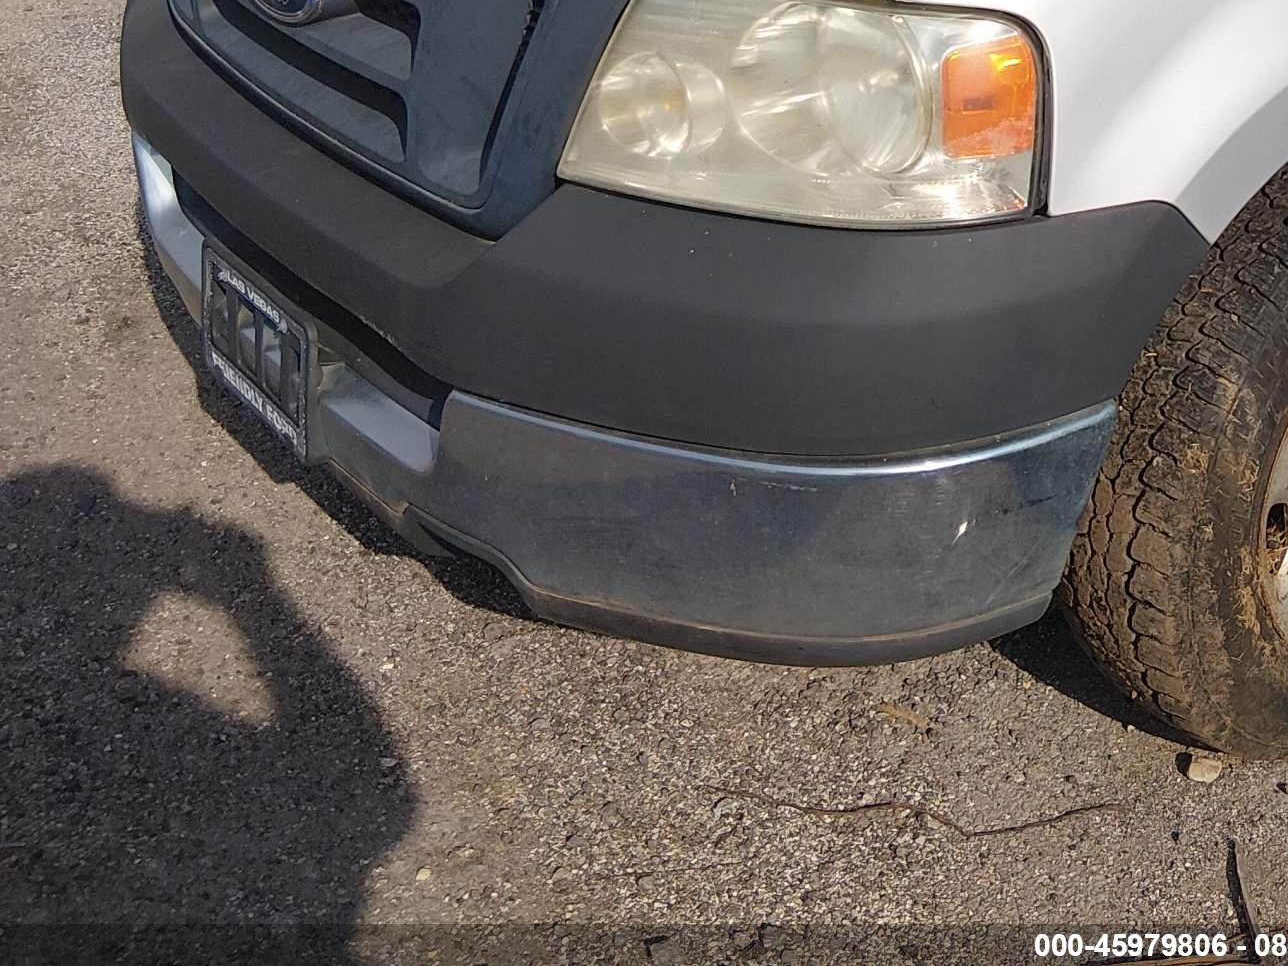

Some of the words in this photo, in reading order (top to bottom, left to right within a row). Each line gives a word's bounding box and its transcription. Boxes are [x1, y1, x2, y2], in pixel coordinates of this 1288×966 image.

[226, 271, 246, 294] LAS
[247, 286, 280, 324] VEGAS
[212, 350, 265, 414] FRIENDLY
[265, 402, 298, 445] FORD
